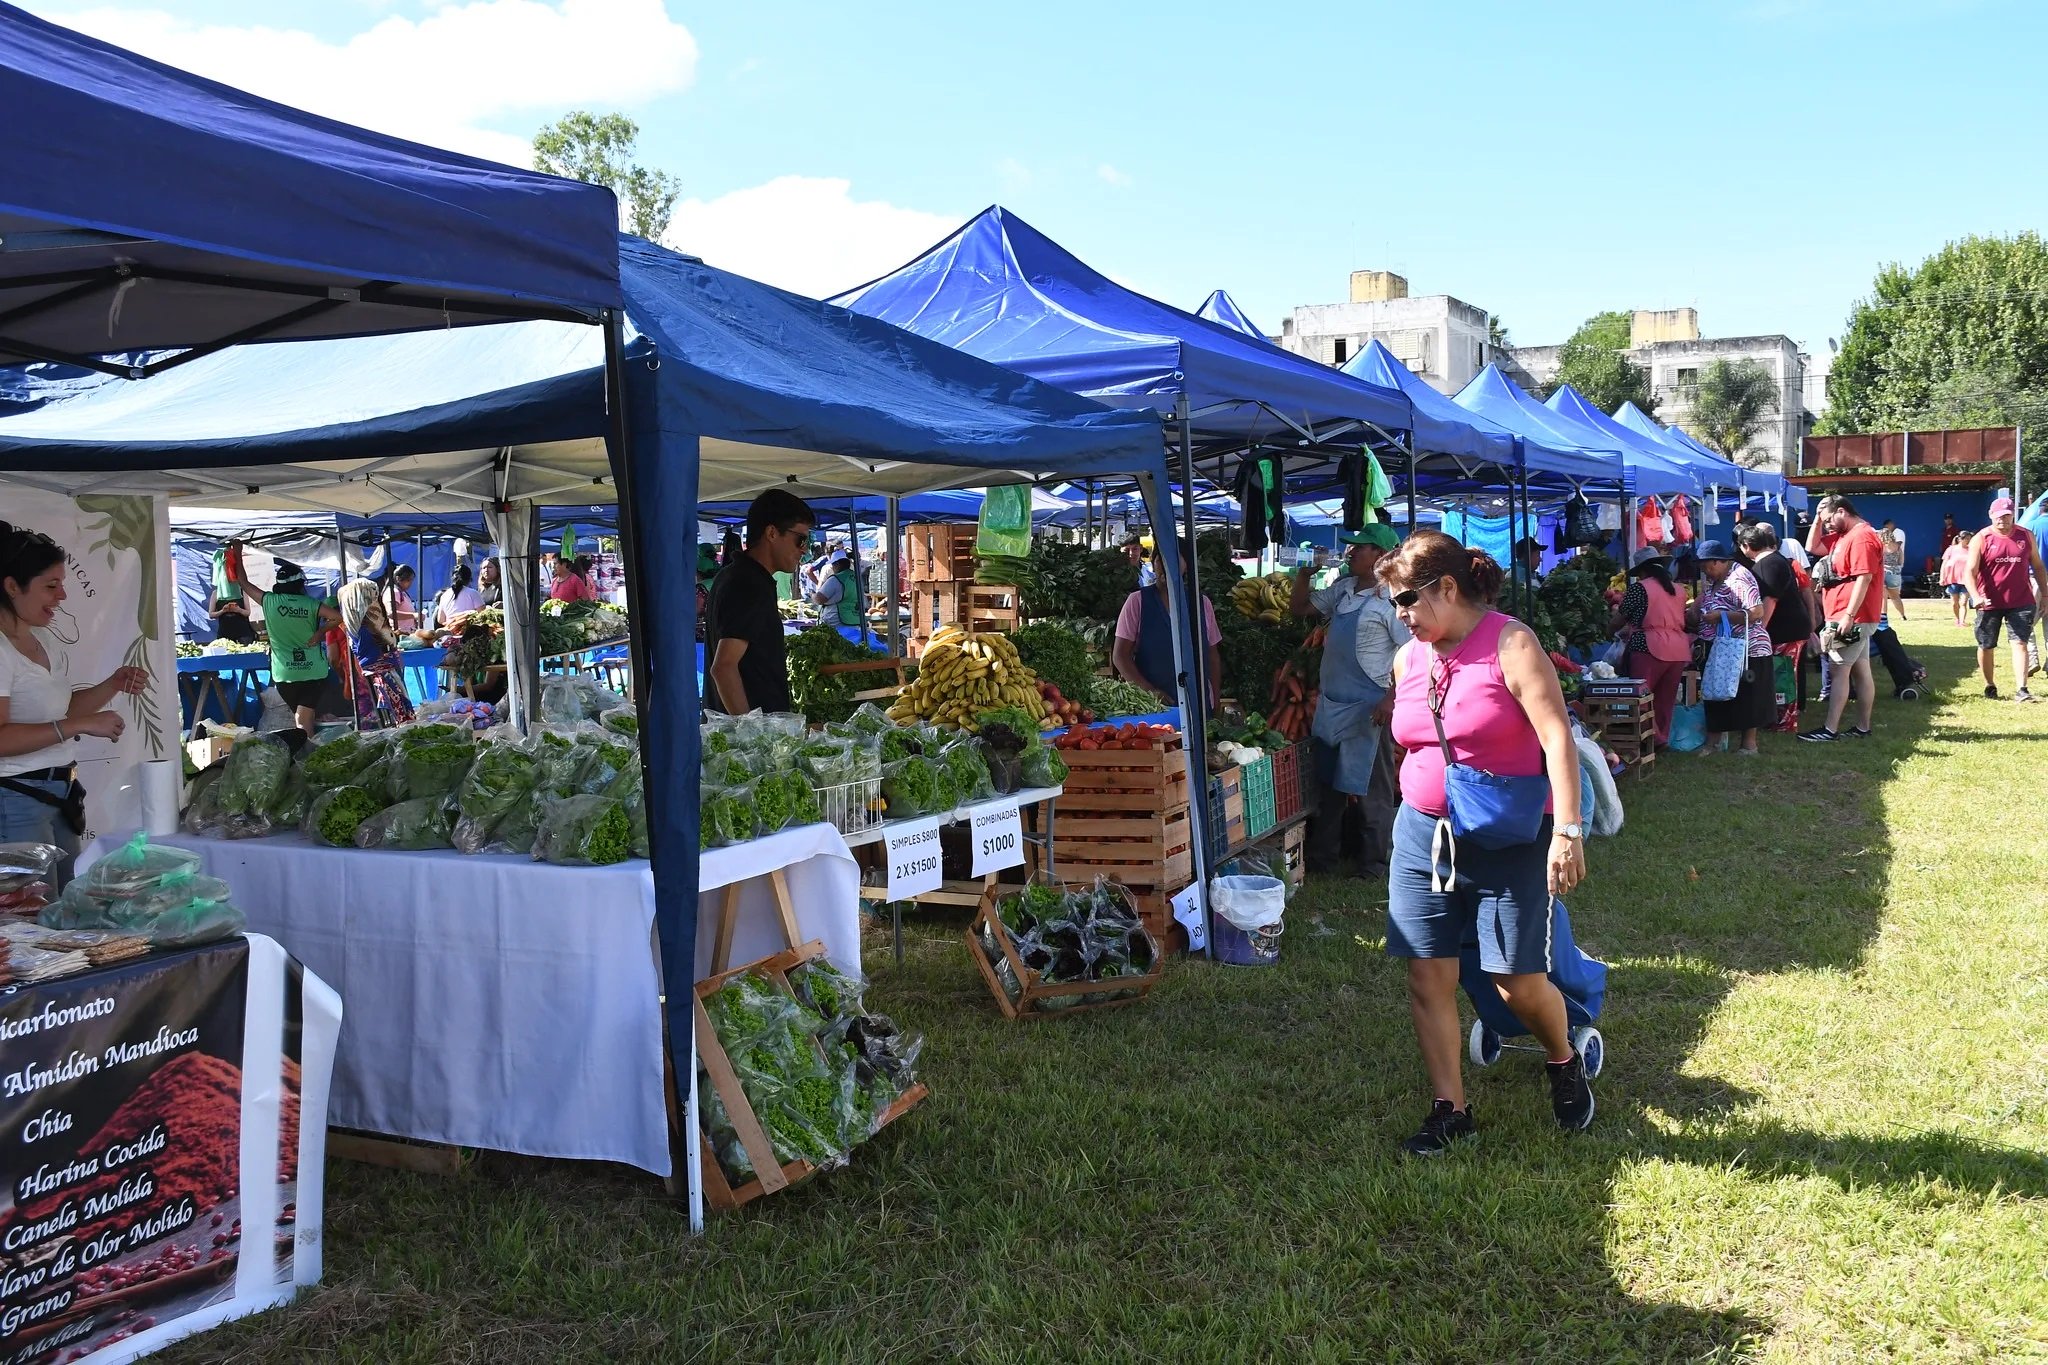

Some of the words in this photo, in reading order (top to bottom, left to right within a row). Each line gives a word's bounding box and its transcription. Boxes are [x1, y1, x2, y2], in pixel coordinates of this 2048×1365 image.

[288, 606, 309, 616] Salta
[891, 834, 921, 850] SIMPLES
[921, 828, 938, 843] $800
[976, 808, 1018, 828] COMBINADAS
[896, 865, 902, 880] 2
[903, 862, 910, 878] X
[911, 855, 937, 876] $1500
[983, 833, 1014, 857] $1000
[0, 997, 116, 1041] icarbonato
[4, 1050, 100, 1097] Almidón
[104, 1025, 199, 1069] Mandioca
[20, 1157, 99, 1199] Harina
[104, 1125, 166, 1168] Cocida
[4, 1201, 78, 1250] Canela
[84, 1173, 153, 1219] Molida
[0, 1267, 47, 1298] lavo
[51, 1245, 75, 1278] de
[81, 1230, 126, 1265] Olor
[130, 1199, 193, 1246] Molido
[1, 1290, 72, 1337] Grano
[17, 1315, 95, 1363] Molida
